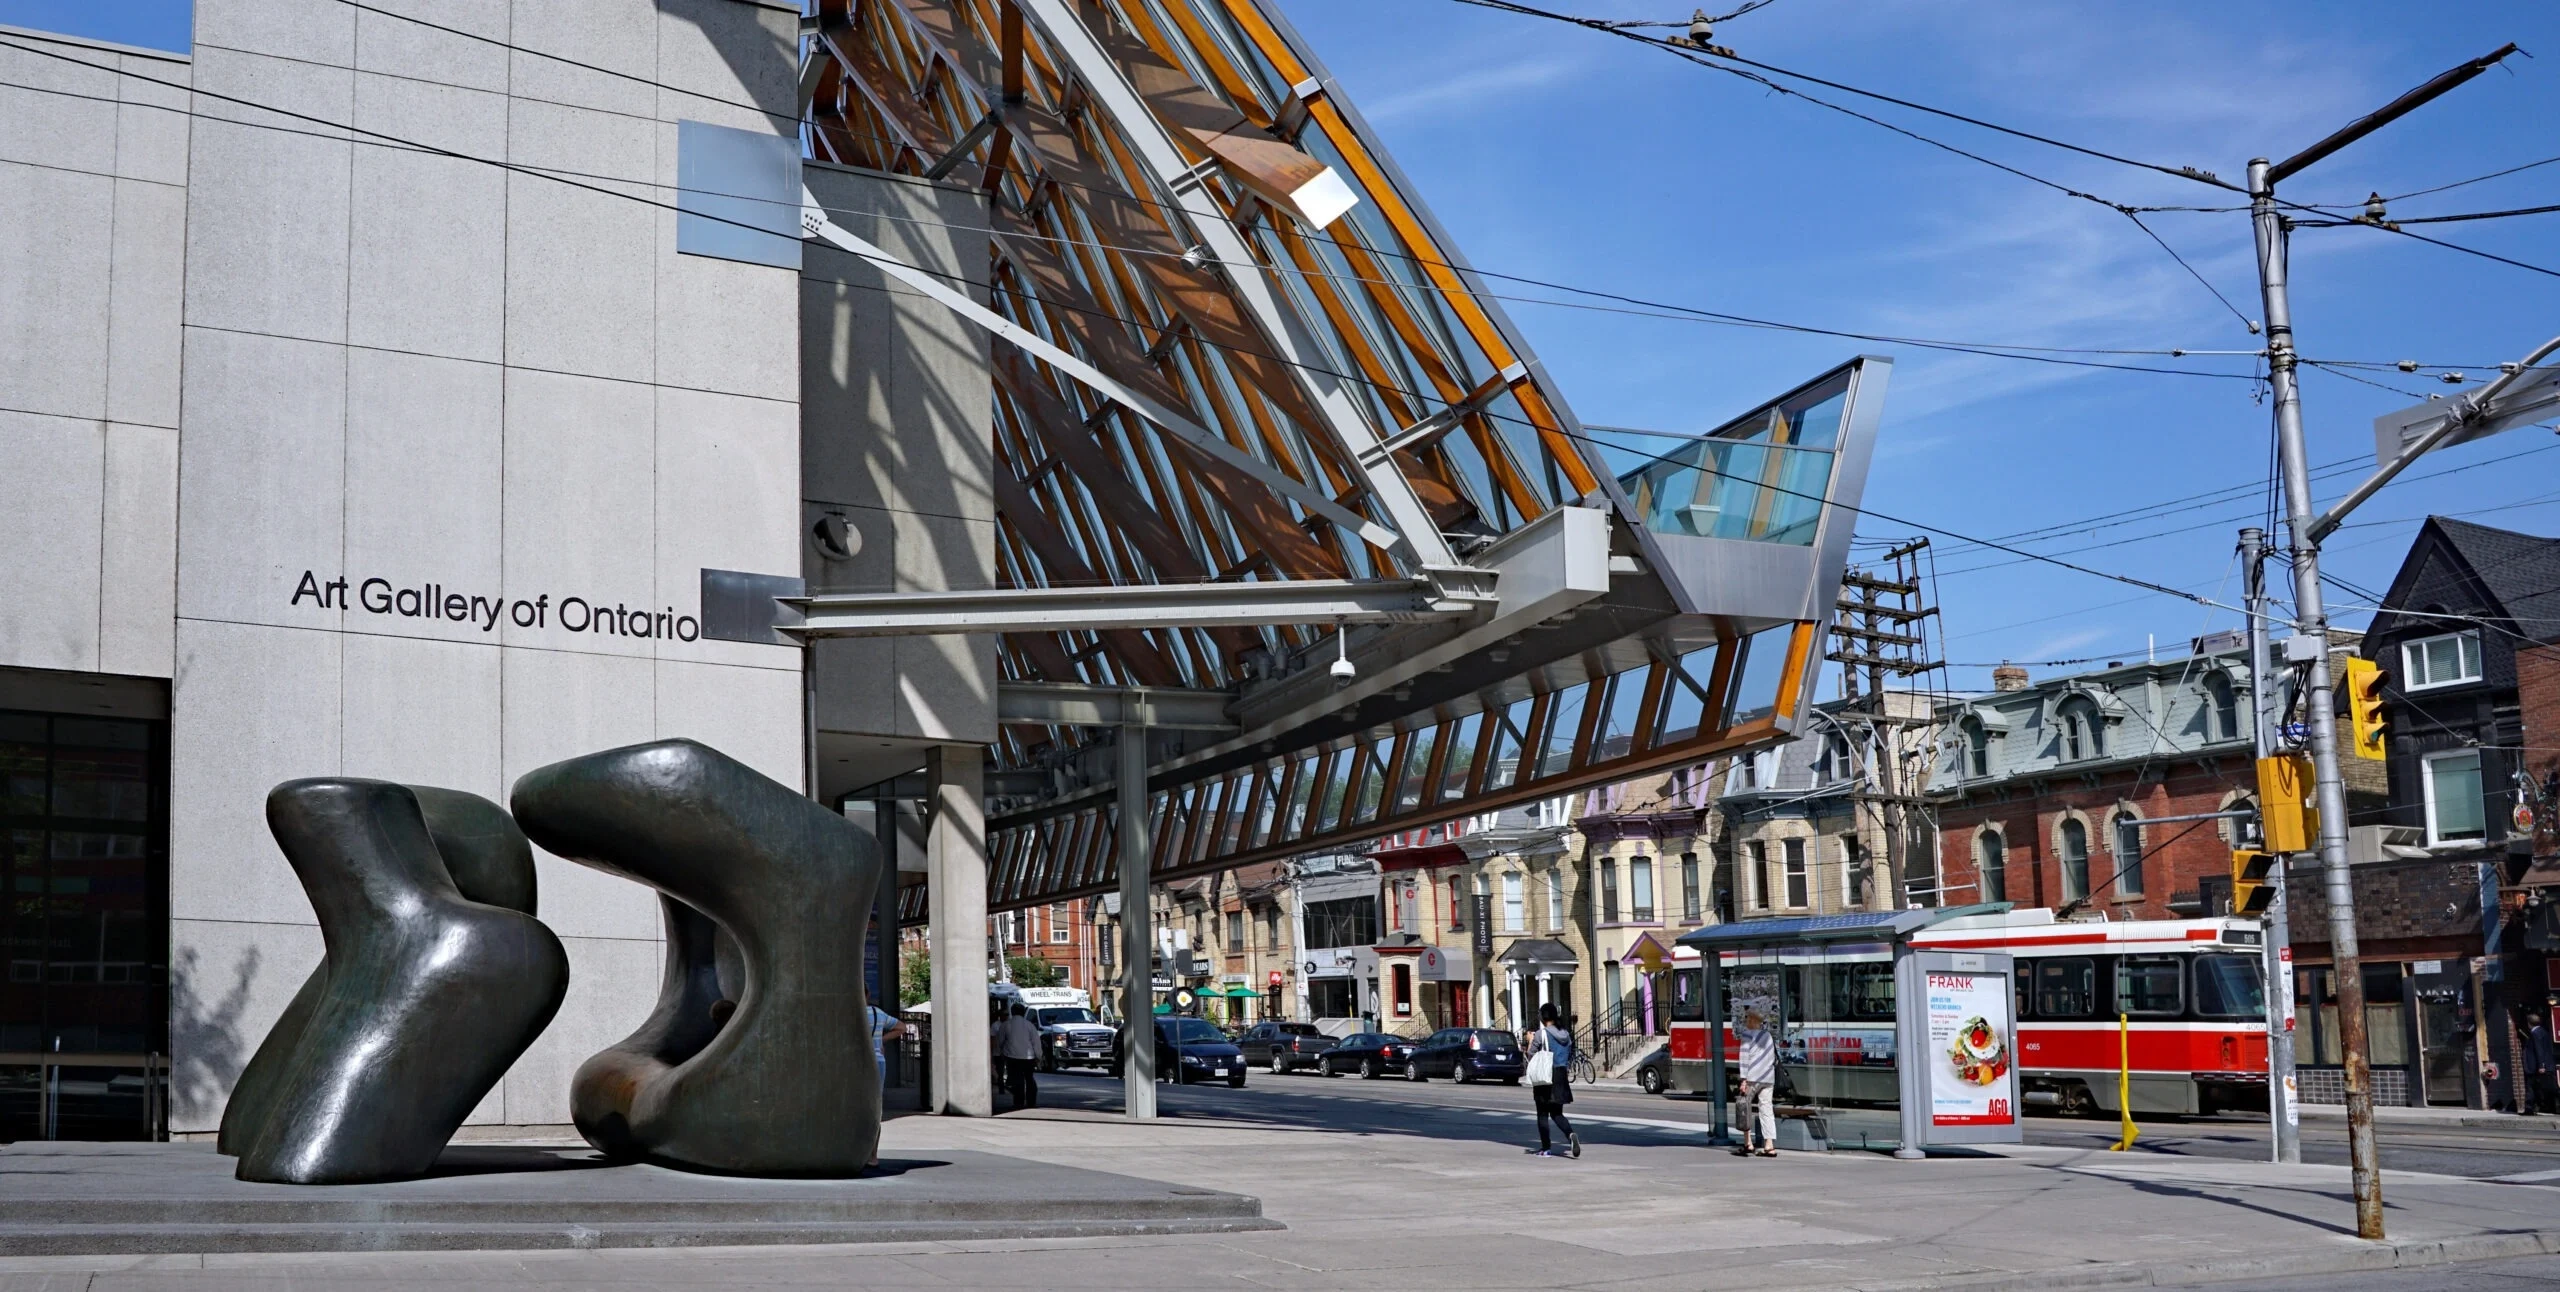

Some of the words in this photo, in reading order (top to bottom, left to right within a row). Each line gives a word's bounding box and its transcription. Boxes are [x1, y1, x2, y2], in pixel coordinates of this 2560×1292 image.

[291, 570, 349, 610] Art
[360, 578, 504, 632] Gallery
[511, 594, 549, 629] of
[559, 597, 699, 643] Ontario
[1929, 976, 1974, 989] FRANK
[1988, 1098, 2008, 1116] AGO
